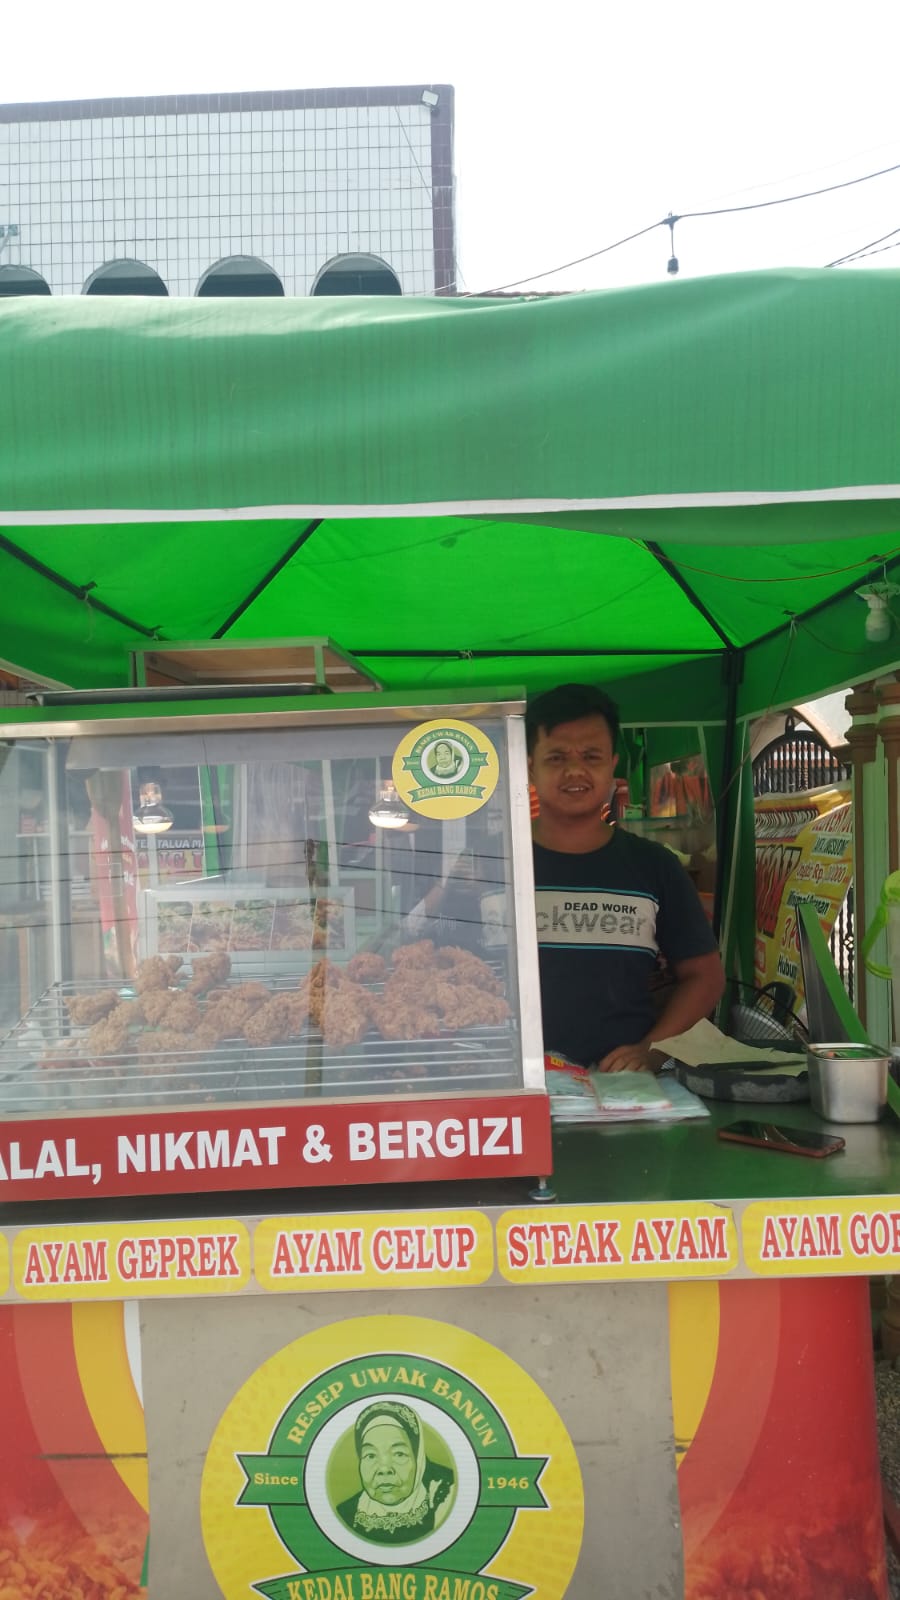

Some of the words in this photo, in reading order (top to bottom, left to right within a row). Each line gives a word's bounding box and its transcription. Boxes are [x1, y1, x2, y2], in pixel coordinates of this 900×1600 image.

[564, 902, 598, 911] DEAD
[602, 903, 638, 915] WORK
[117, 1126, 287, 1174] NIKMAT
[302, 1124, 333, 1163] &
[349, 1116, 523, 1161] BERGIZI
[24, 1241, 109, 1284] AYAM
[117, 1235, 240, 1280] GEPREK
[272, 1230, 362, 1275] AYAM
[372, 1227, 476, 1271] CELUP
[508, 1221, 622, 1267] STEAK
[631, 1218, 728, 1262] AYAM
[761, 1215, 842, 1259] AYAM
[286, 1381, 345, 1446] RESEP
[349, 1366, 427, 1389] UWAK
[432, 1378, 498, 1448] BANUN
[254, 1472, 299, 1486] Since
[486, 1477, 529, 1490] 1946
[286, 1573, 353, 1600] KEDAI
[360, 1573, 417, 1600] BANG
[424, 1574, 499, 1600] RAMOS
